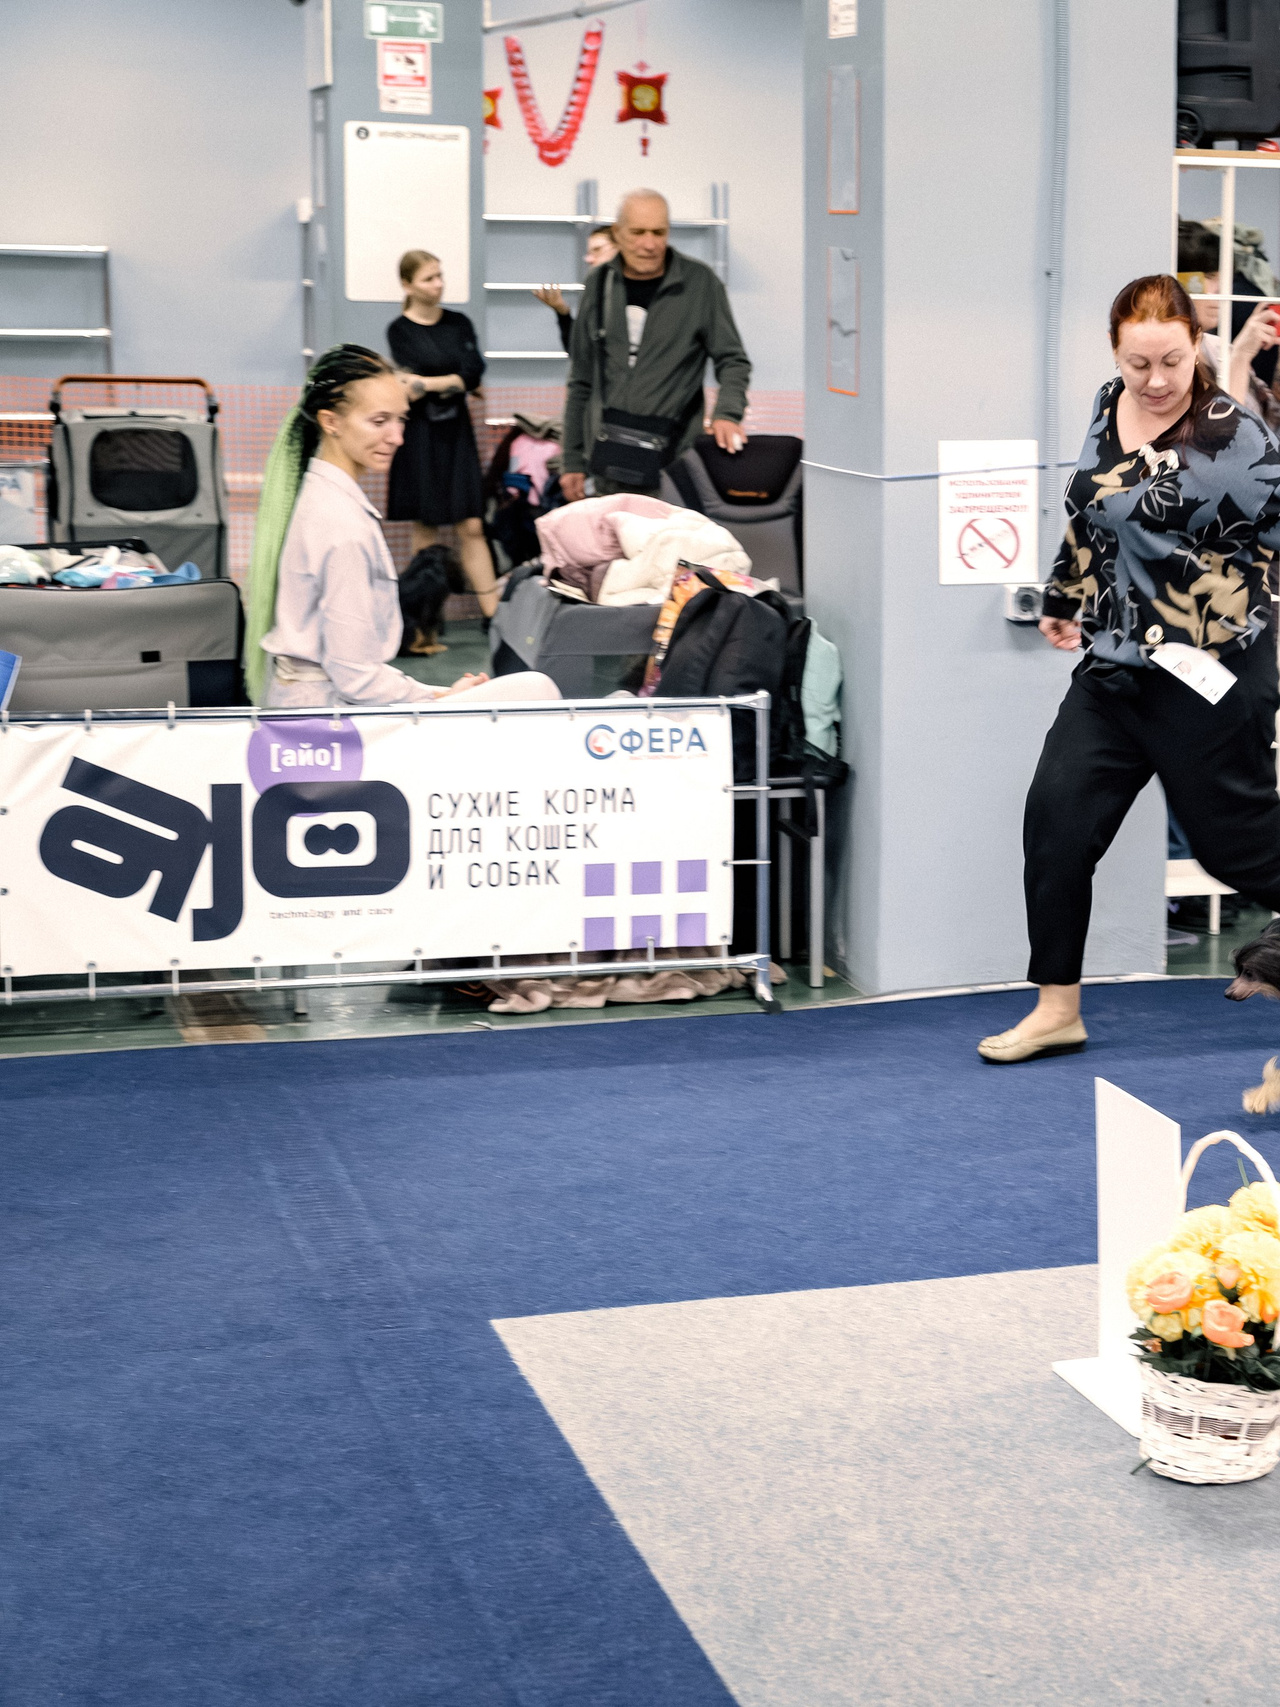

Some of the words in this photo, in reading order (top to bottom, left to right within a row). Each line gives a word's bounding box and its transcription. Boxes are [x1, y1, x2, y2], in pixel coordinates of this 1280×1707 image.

[584, 723, 708, 760] СФЕРА
[427, 790, 520, 819] СУХИЕ
[543, 787, 637, 815] КОРМА
[427, 827, 483, 860] ДЛЯ
[506, 823, 599, 852] КОШЕК
[428, 863, 445, 890] И
[467, 859, 561, 889] СОБАК
